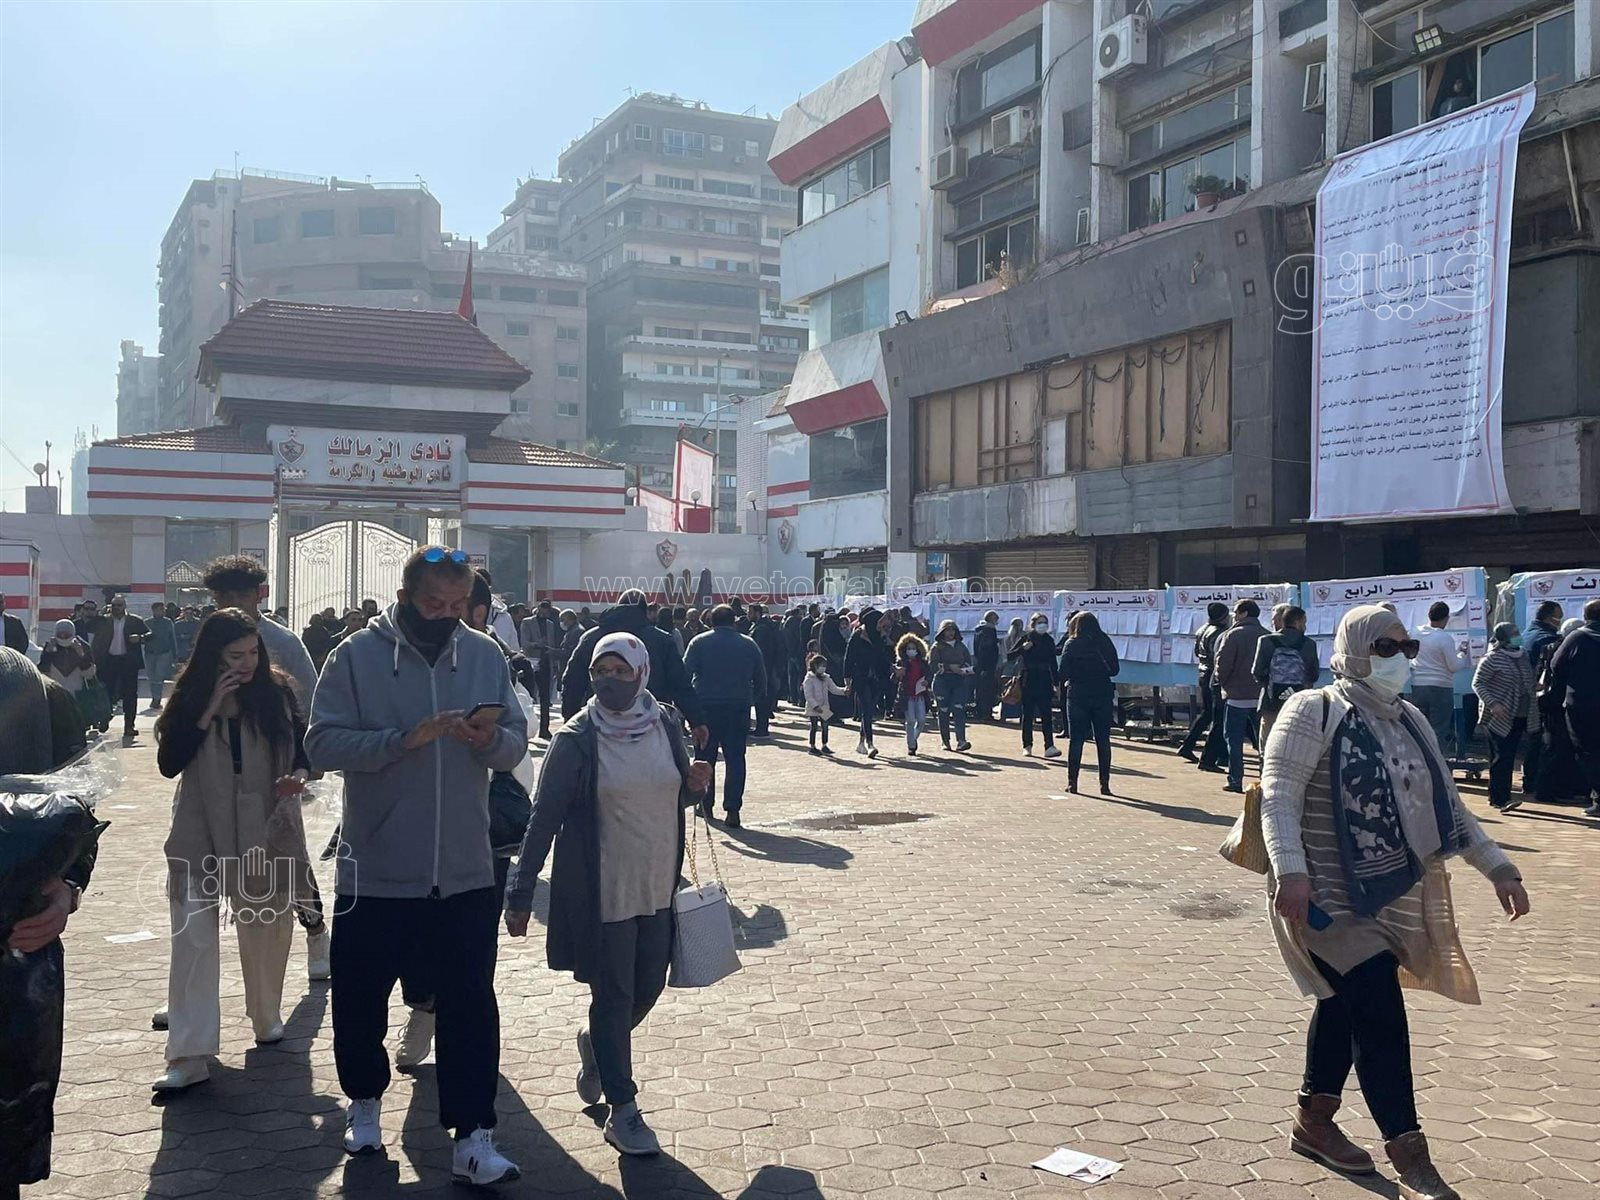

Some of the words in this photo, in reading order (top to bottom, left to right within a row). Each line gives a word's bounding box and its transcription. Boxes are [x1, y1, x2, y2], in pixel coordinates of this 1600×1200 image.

[327, 435, 402, 463] الزمالك
[1344, 583, 1383, 599] الرابع
[1387, 580, 1434, 595] المقر
[959, 596, 994, 607] السابع
[998, 595, 1031, 605] المقر
[1079, 596, 1114, 607] السادس
[1116, 595, 1146, 607] المقر
[1193, 592, 1232, 604] الخامس
